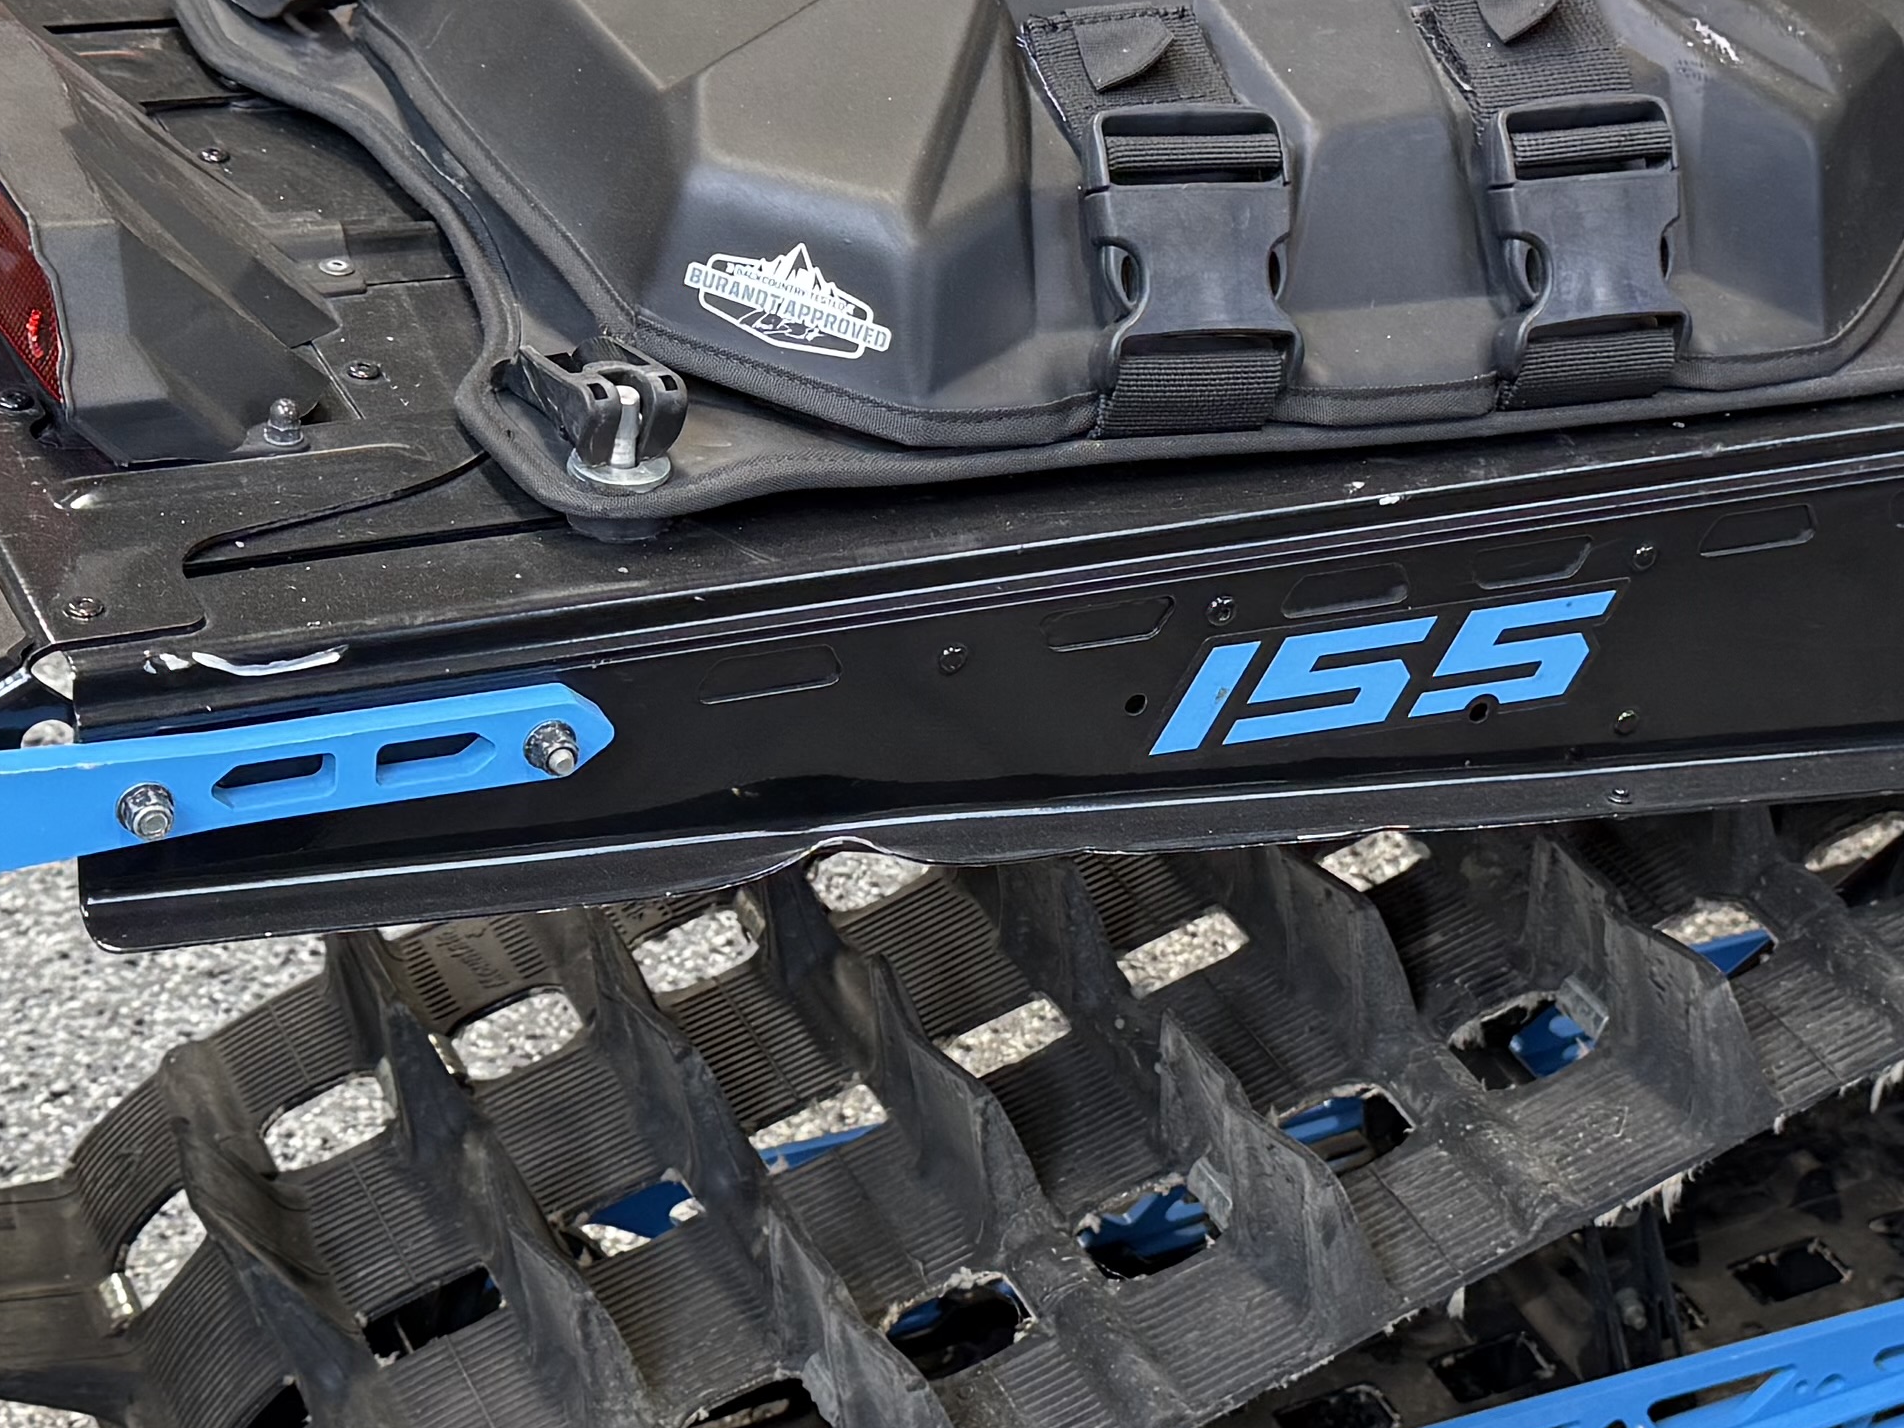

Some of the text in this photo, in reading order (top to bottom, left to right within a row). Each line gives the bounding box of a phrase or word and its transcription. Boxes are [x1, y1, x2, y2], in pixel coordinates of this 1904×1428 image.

[688, 266, 782, 314] BURANDT
[783, 299, 888, 349] APPROVED
[1148, 589, 1618, 757] 155
